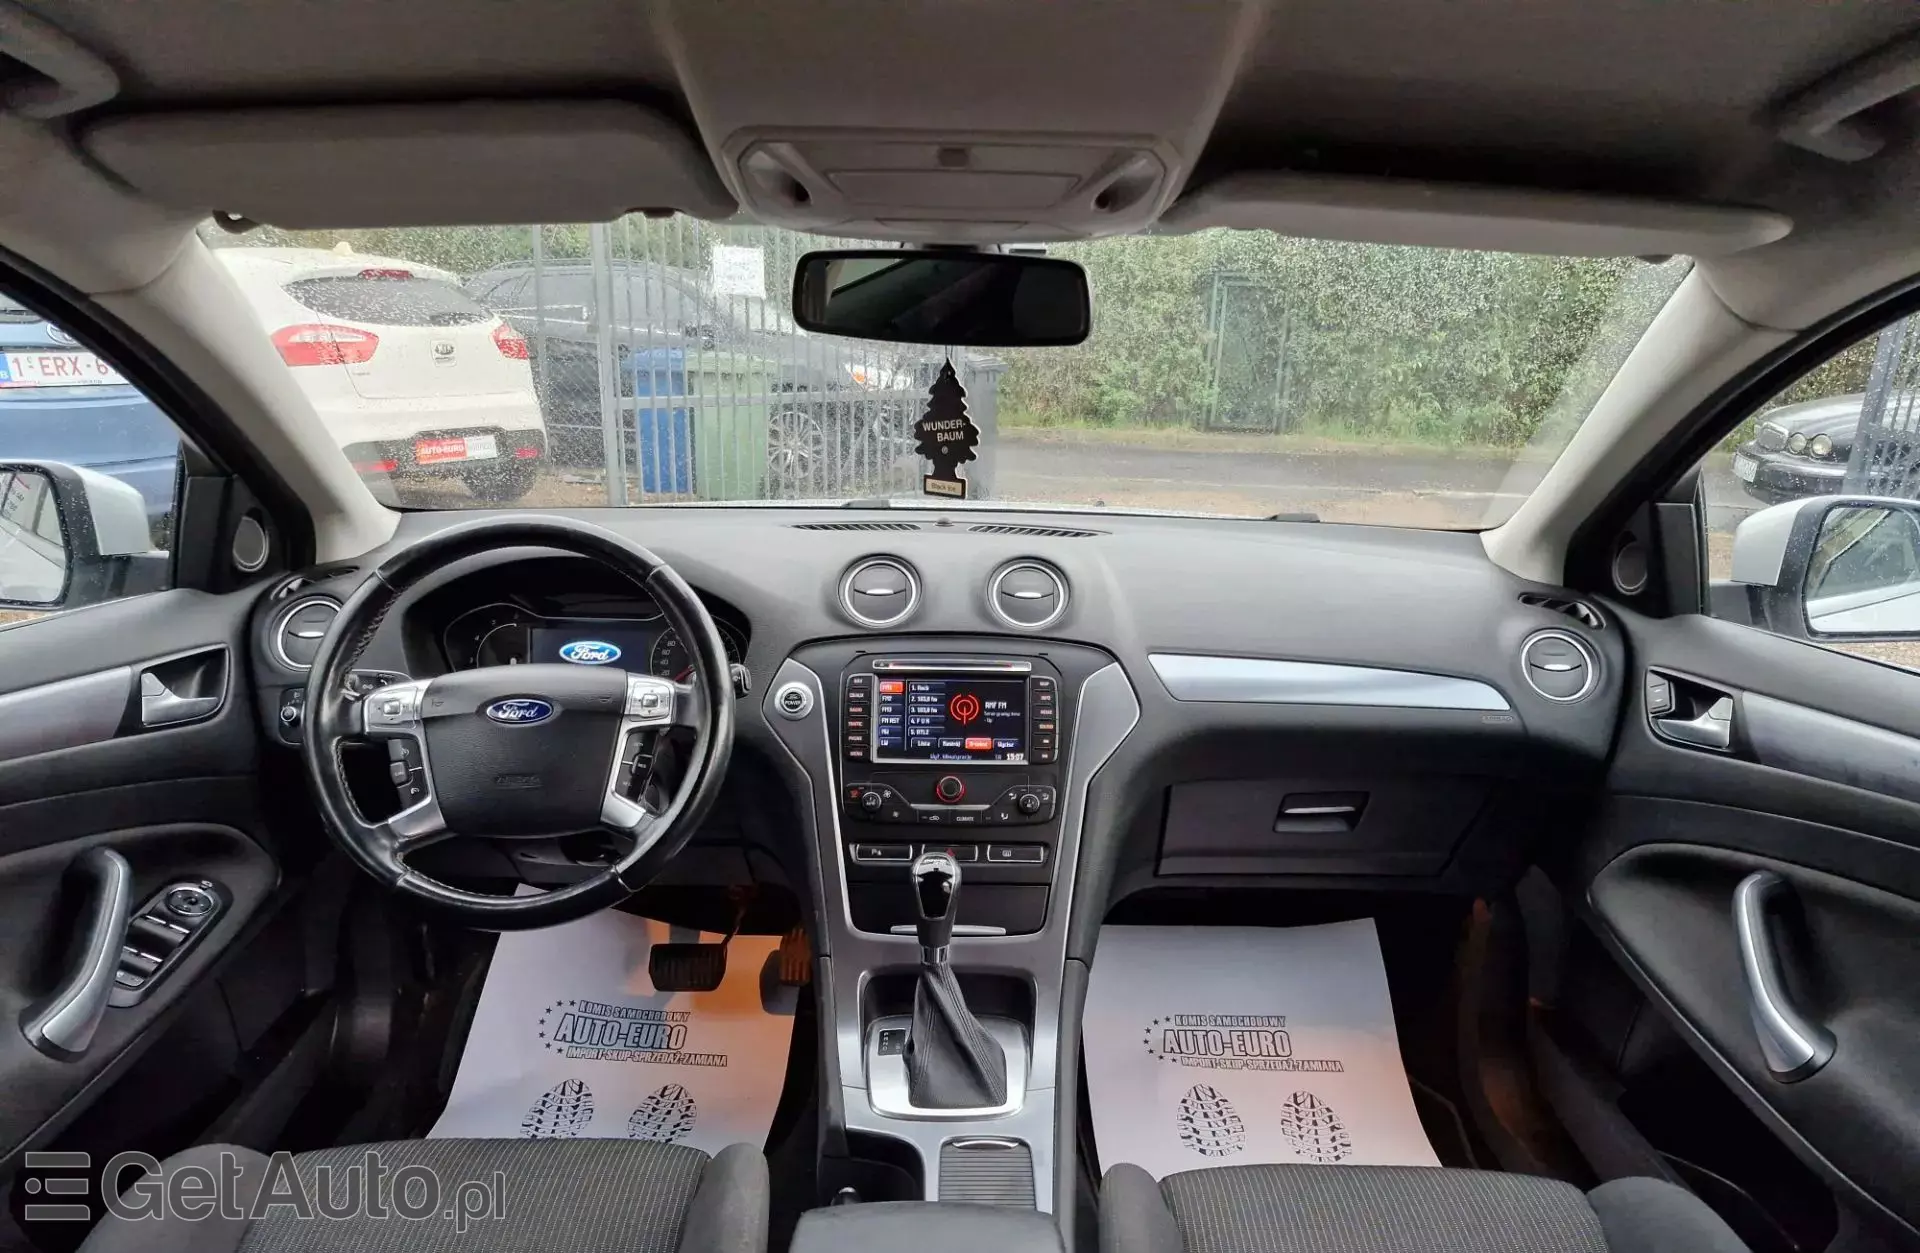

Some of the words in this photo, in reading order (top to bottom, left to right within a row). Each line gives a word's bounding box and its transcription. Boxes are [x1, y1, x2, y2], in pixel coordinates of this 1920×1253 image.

[922, 419, 966, 432] WUNDER-
[937, 431, 964, 442] BAUM
[568, 642, 611, 663] Ford
[496, 700, 541, 720] Ford
[579, 1000, 611, 1017] KOMIS
[613, 1007, 690, 1022] SAMOCHODOWY
[1174, 1015, 1207, 1026] KOMIS
[1209, 1015, 1286, 1027] SAMOCHODOWY
[554, 1013, 688, 1050] AUTO-EURO
[1163, 1029, 1292, 1057] AUTO-EURO
